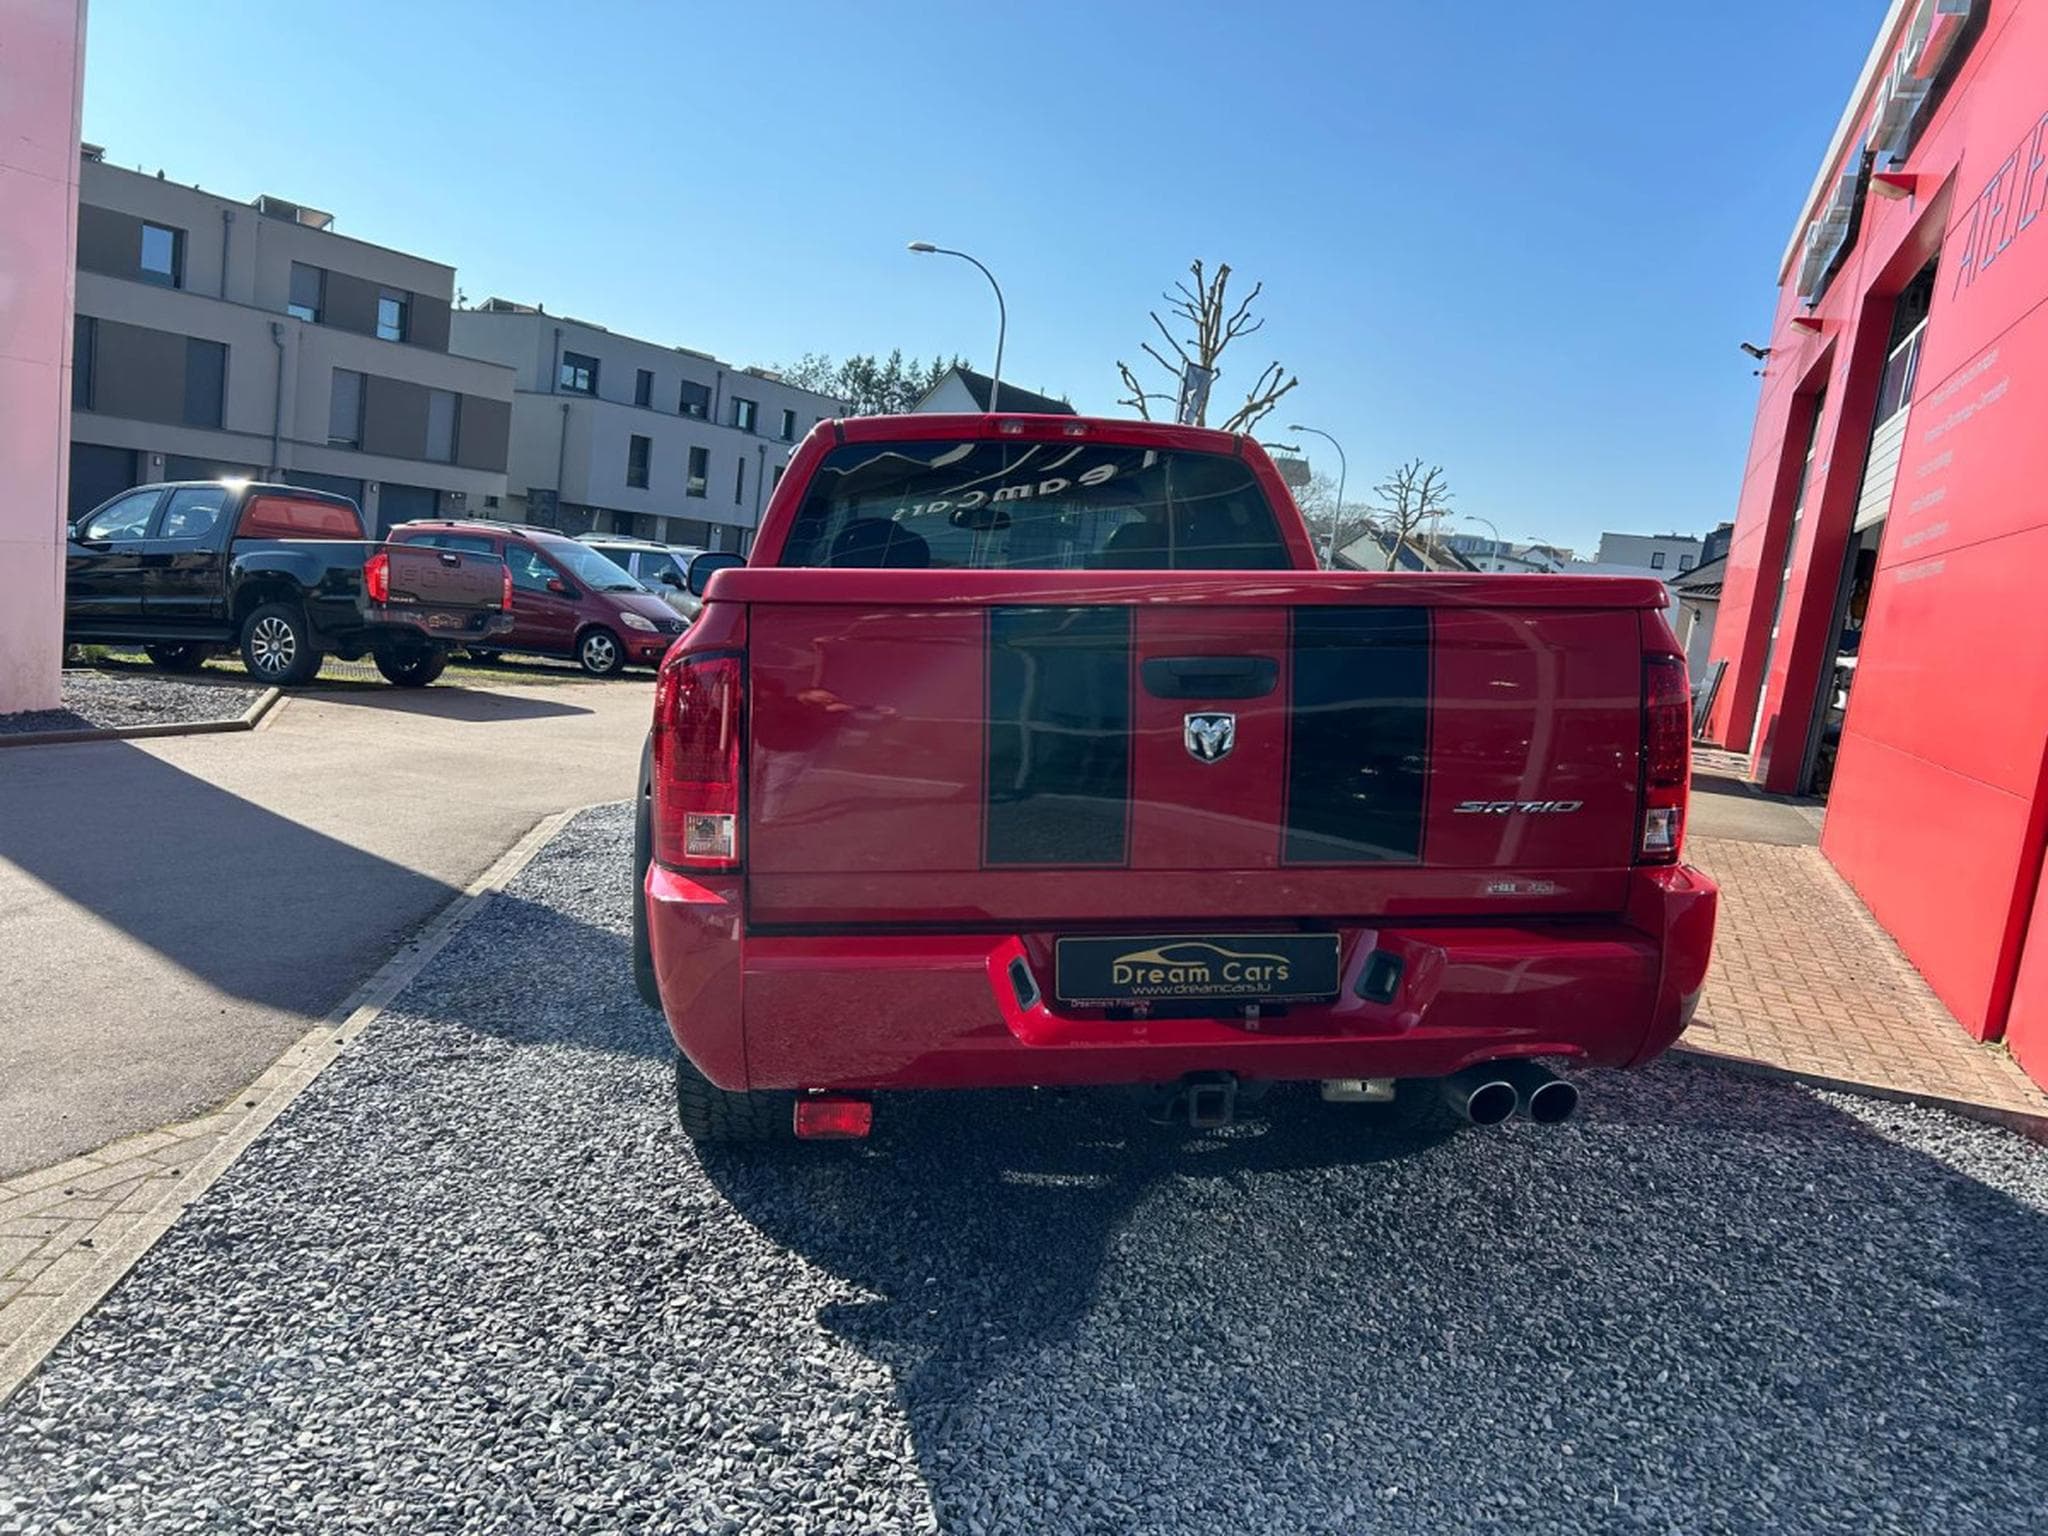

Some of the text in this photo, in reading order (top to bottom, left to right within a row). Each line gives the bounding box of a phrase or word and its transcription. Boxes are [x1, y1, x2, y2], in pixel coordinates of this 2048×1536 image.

[1952, 110, 2048, 302] ATELIE
[1112, 962, 1290, 984] Dream Cars
[1131, 983, 1271, 996] www.dreamcars.lu
